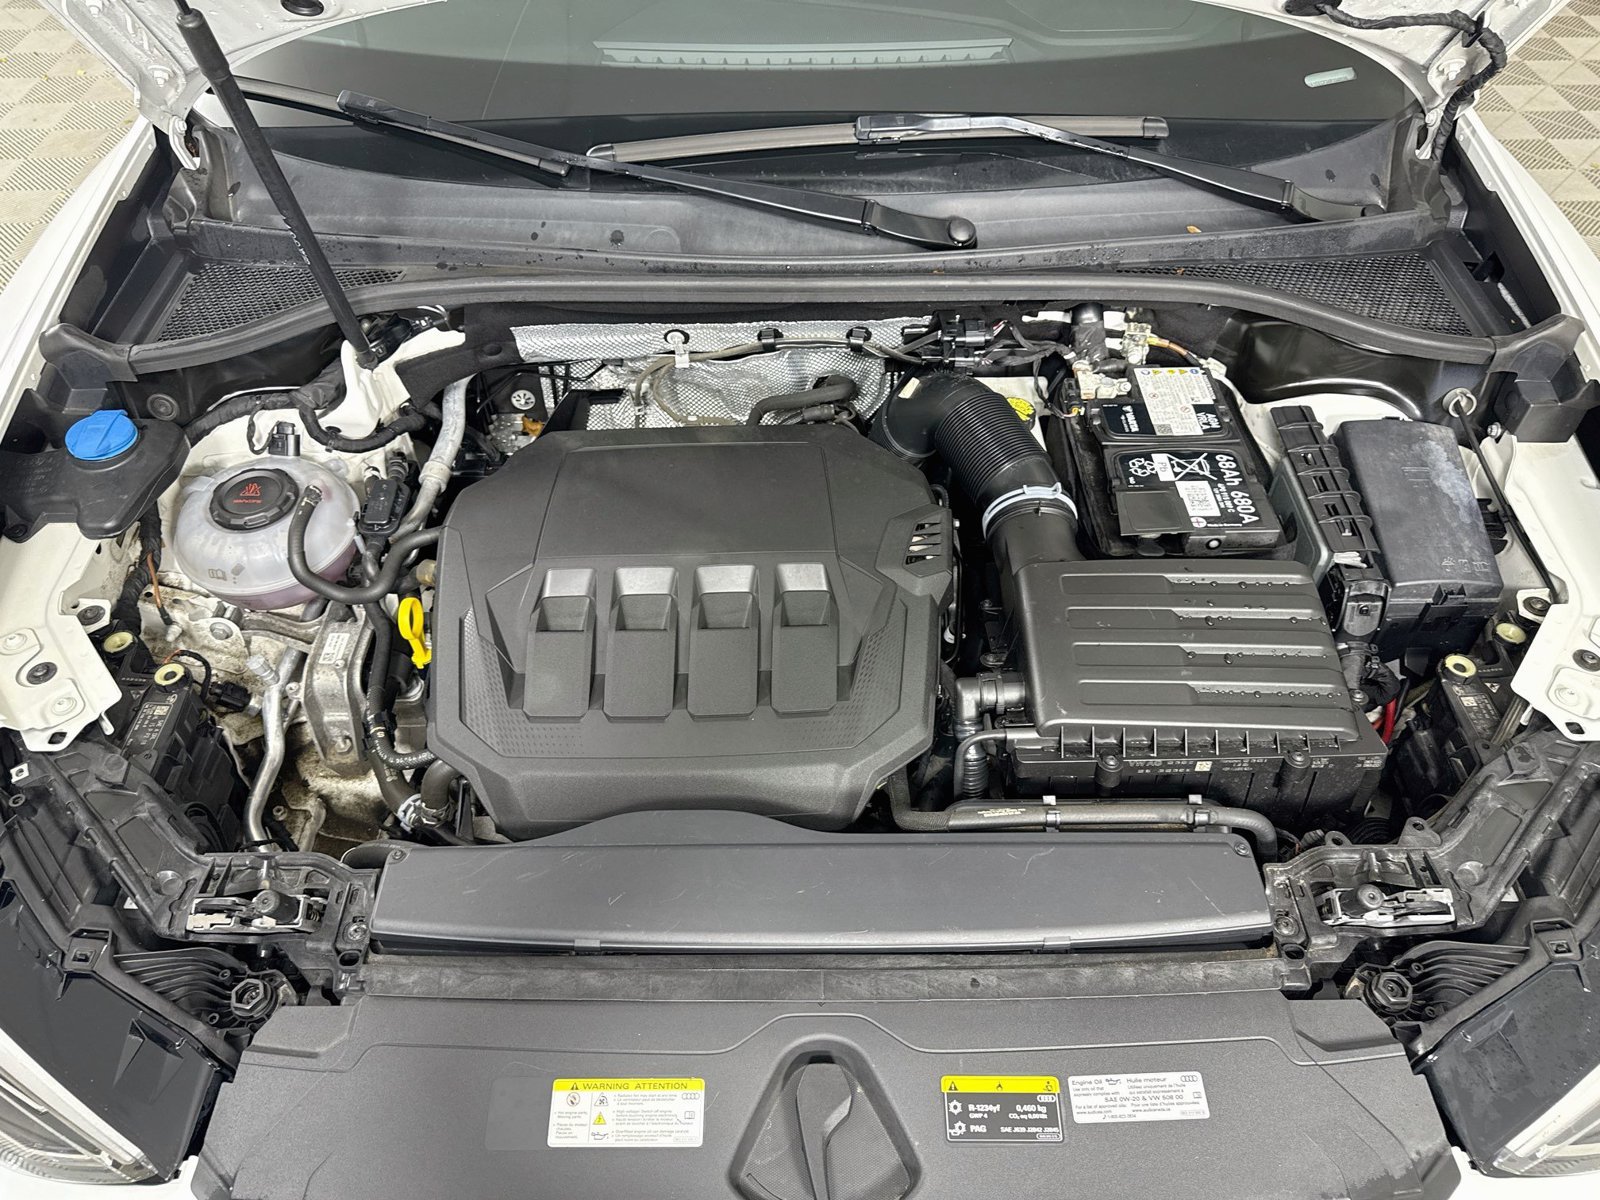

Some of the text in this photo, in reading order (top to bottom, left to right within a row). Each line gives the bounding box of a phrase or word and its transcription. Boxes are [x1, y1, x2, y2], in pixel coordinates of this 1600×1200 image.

[1197, 412, 1210, 429] VRLA
[1206, 413, 1220, 428] AGM
[1158, 462, 1168, 472] Pb
[1216, 454, 1242, 486] 68Ah
[1231, 490, 1260, 524] 680A
[968, 1104, 1000, 1113] R-1234yf
